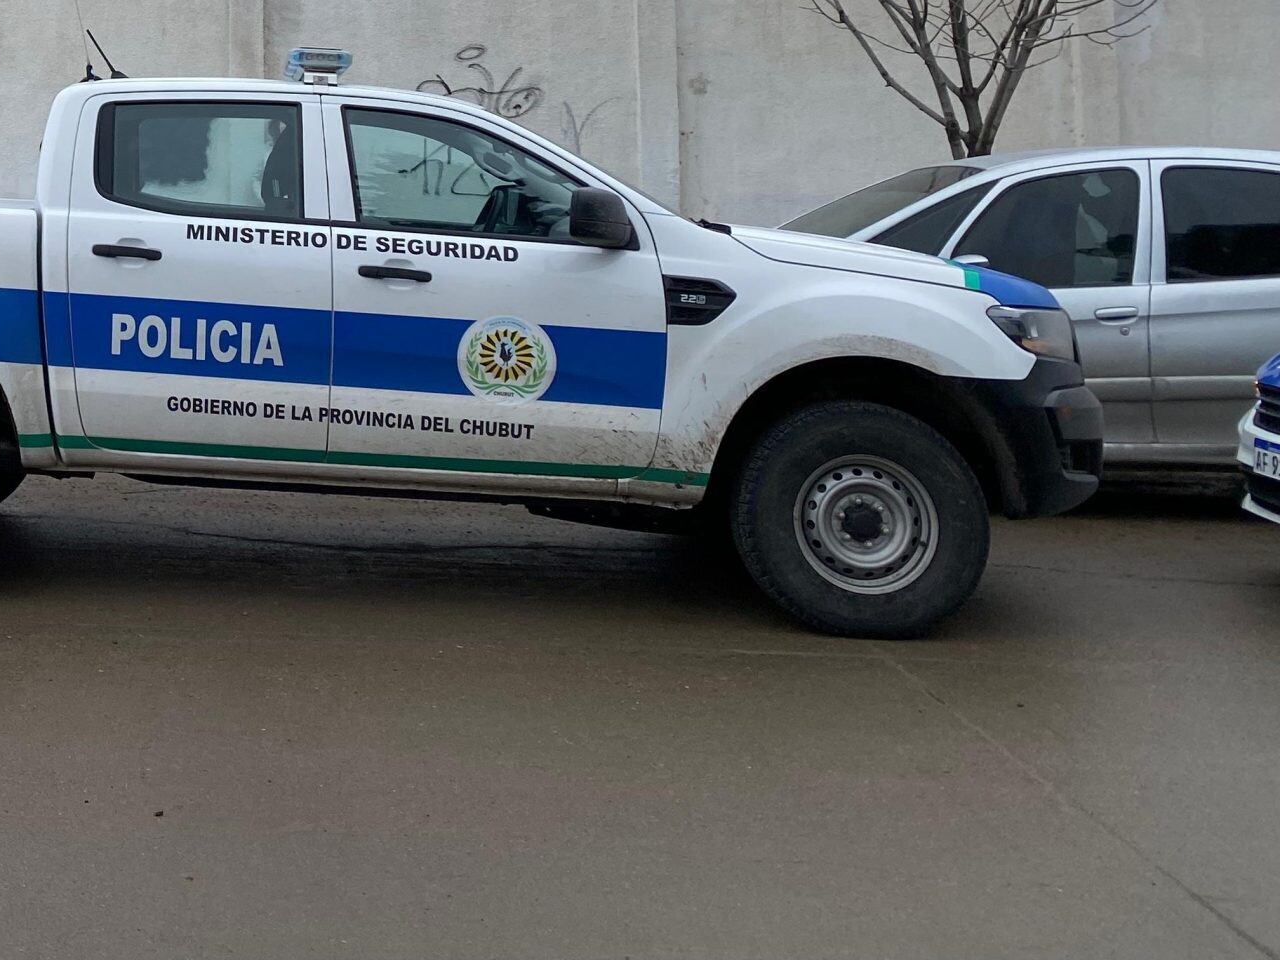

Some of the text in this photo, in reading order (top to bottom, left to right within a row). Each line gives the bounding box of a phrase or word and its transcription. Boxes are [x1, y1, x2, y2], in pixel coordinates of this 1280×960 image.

[186, 224, 519, 262] MINISTERIO DE SEGURIDAD
[111, 313, 284, 367] POLICIA
[167, 396, 535, 440] GOBIERNO DE LA PROVINCIA DEL CHUBUT
[1256, 451, 1269, 472] AF
